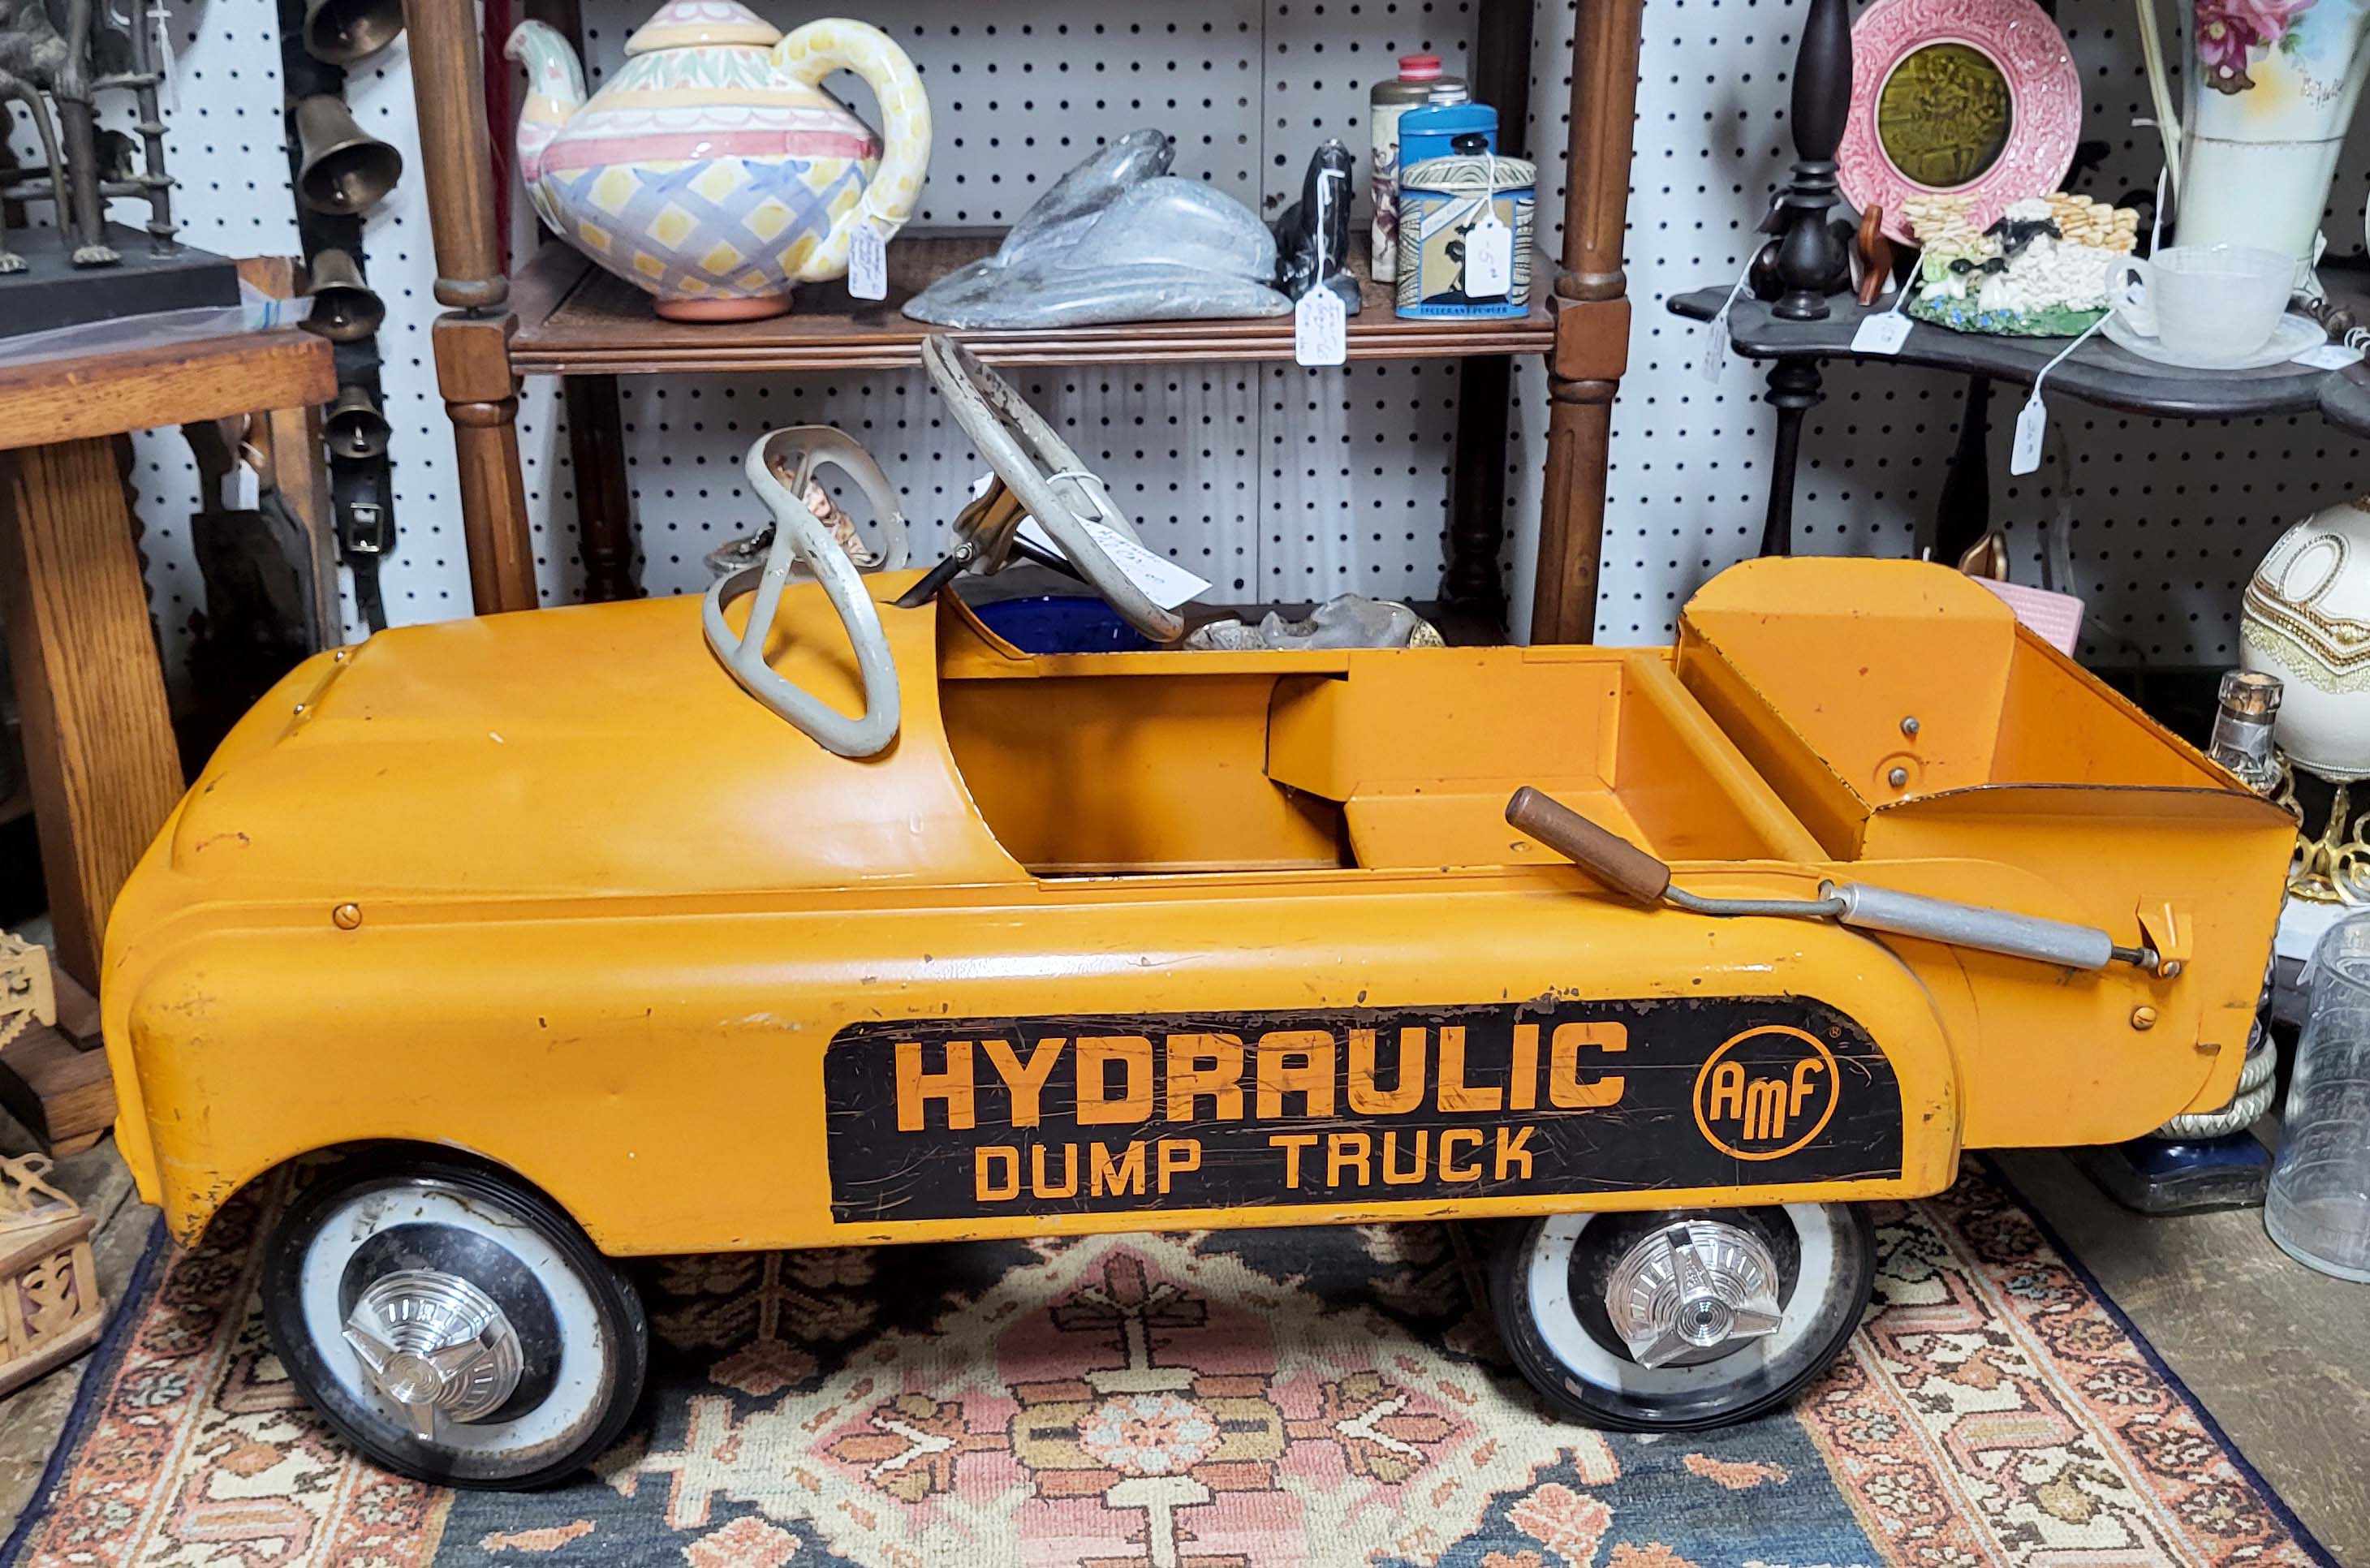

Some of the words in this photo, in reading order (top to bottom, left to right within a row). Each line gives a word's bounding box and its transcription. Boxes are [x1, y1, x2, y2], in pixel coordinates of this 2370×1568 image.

[894, 1021, 1628, 1132] HYDRAULIC
[975, 1139, 1201, 1202] DUMP
[1269, 1126, 1536, 1189] TRUCK
